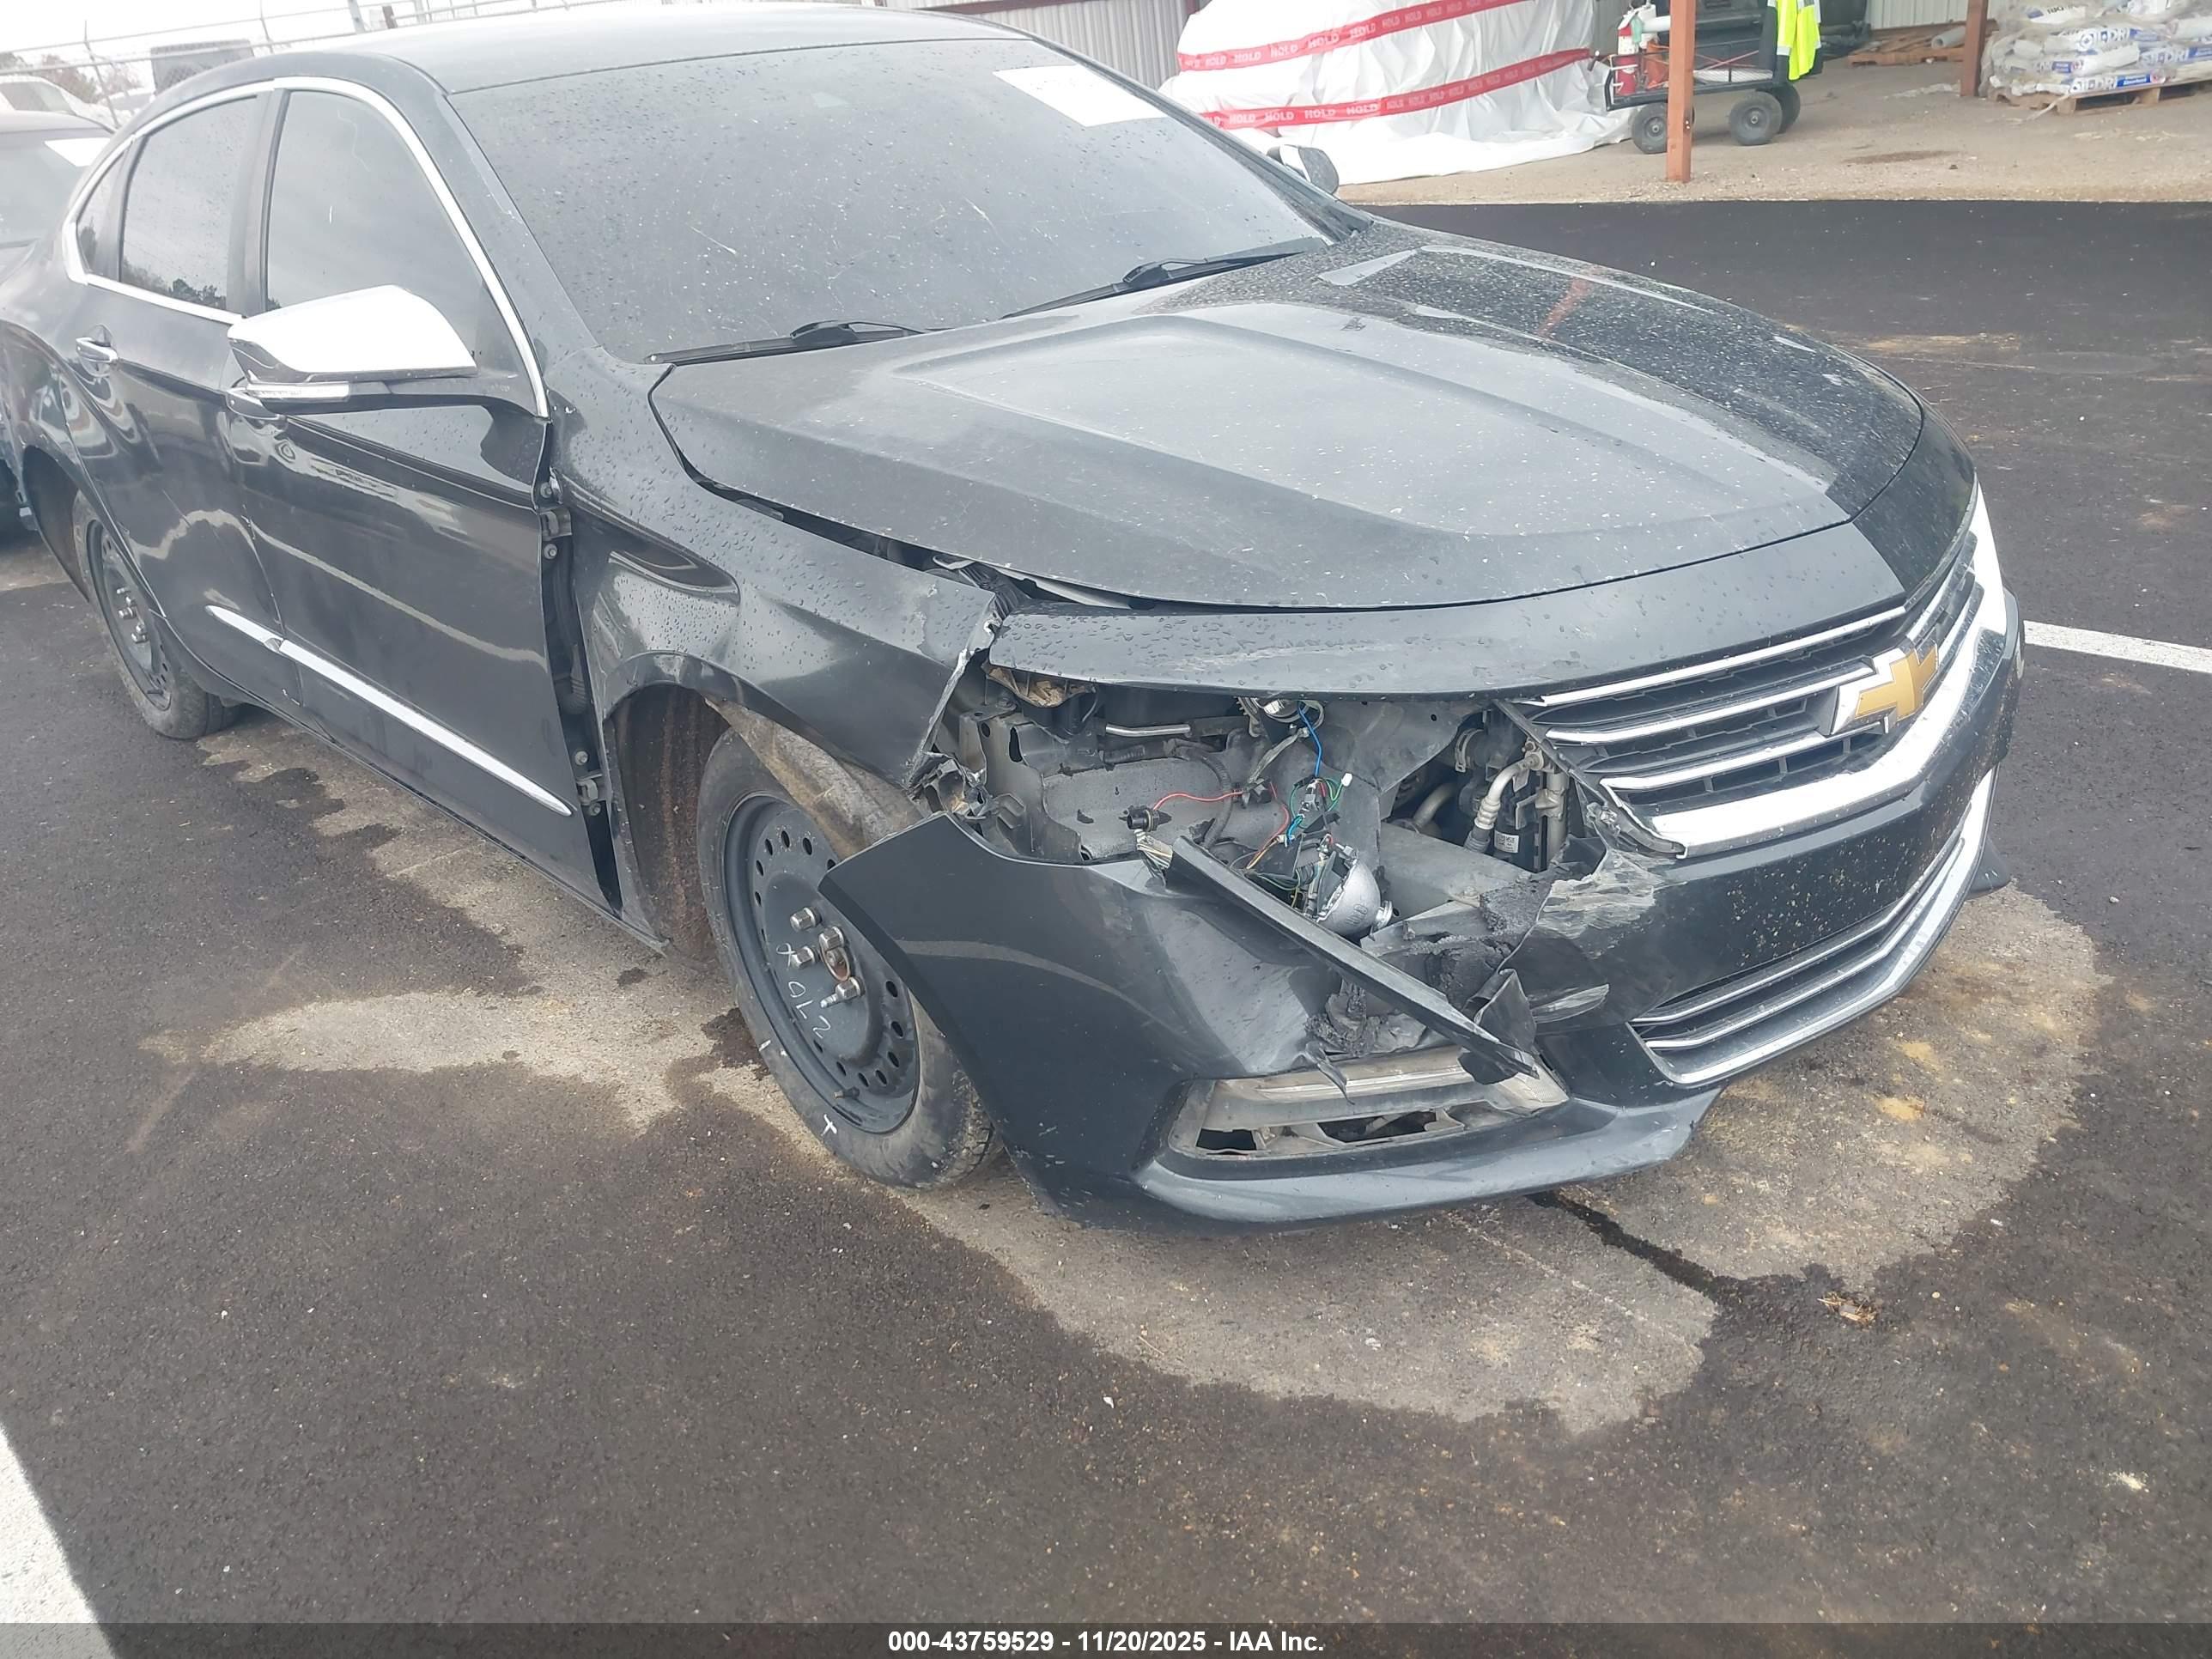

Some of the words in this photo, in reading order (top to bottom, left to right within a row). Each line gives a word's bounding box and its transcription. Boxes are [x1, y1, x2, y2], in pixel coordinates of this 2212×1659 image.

[1234, 52, 1261, 64] HOLD
[1270, 45, 1298, 58] HOLD
[1308, 33, 1340, 48] HOLD
[1349, 23, 1376, 37] HOLD
[1229, 113, 1255, 124] HOLD
[1265, 112, 1294, 122] HOLD
[1304, 109, 1336, 119] HOLD
[1346, 103, 1379, 115] HOLD
